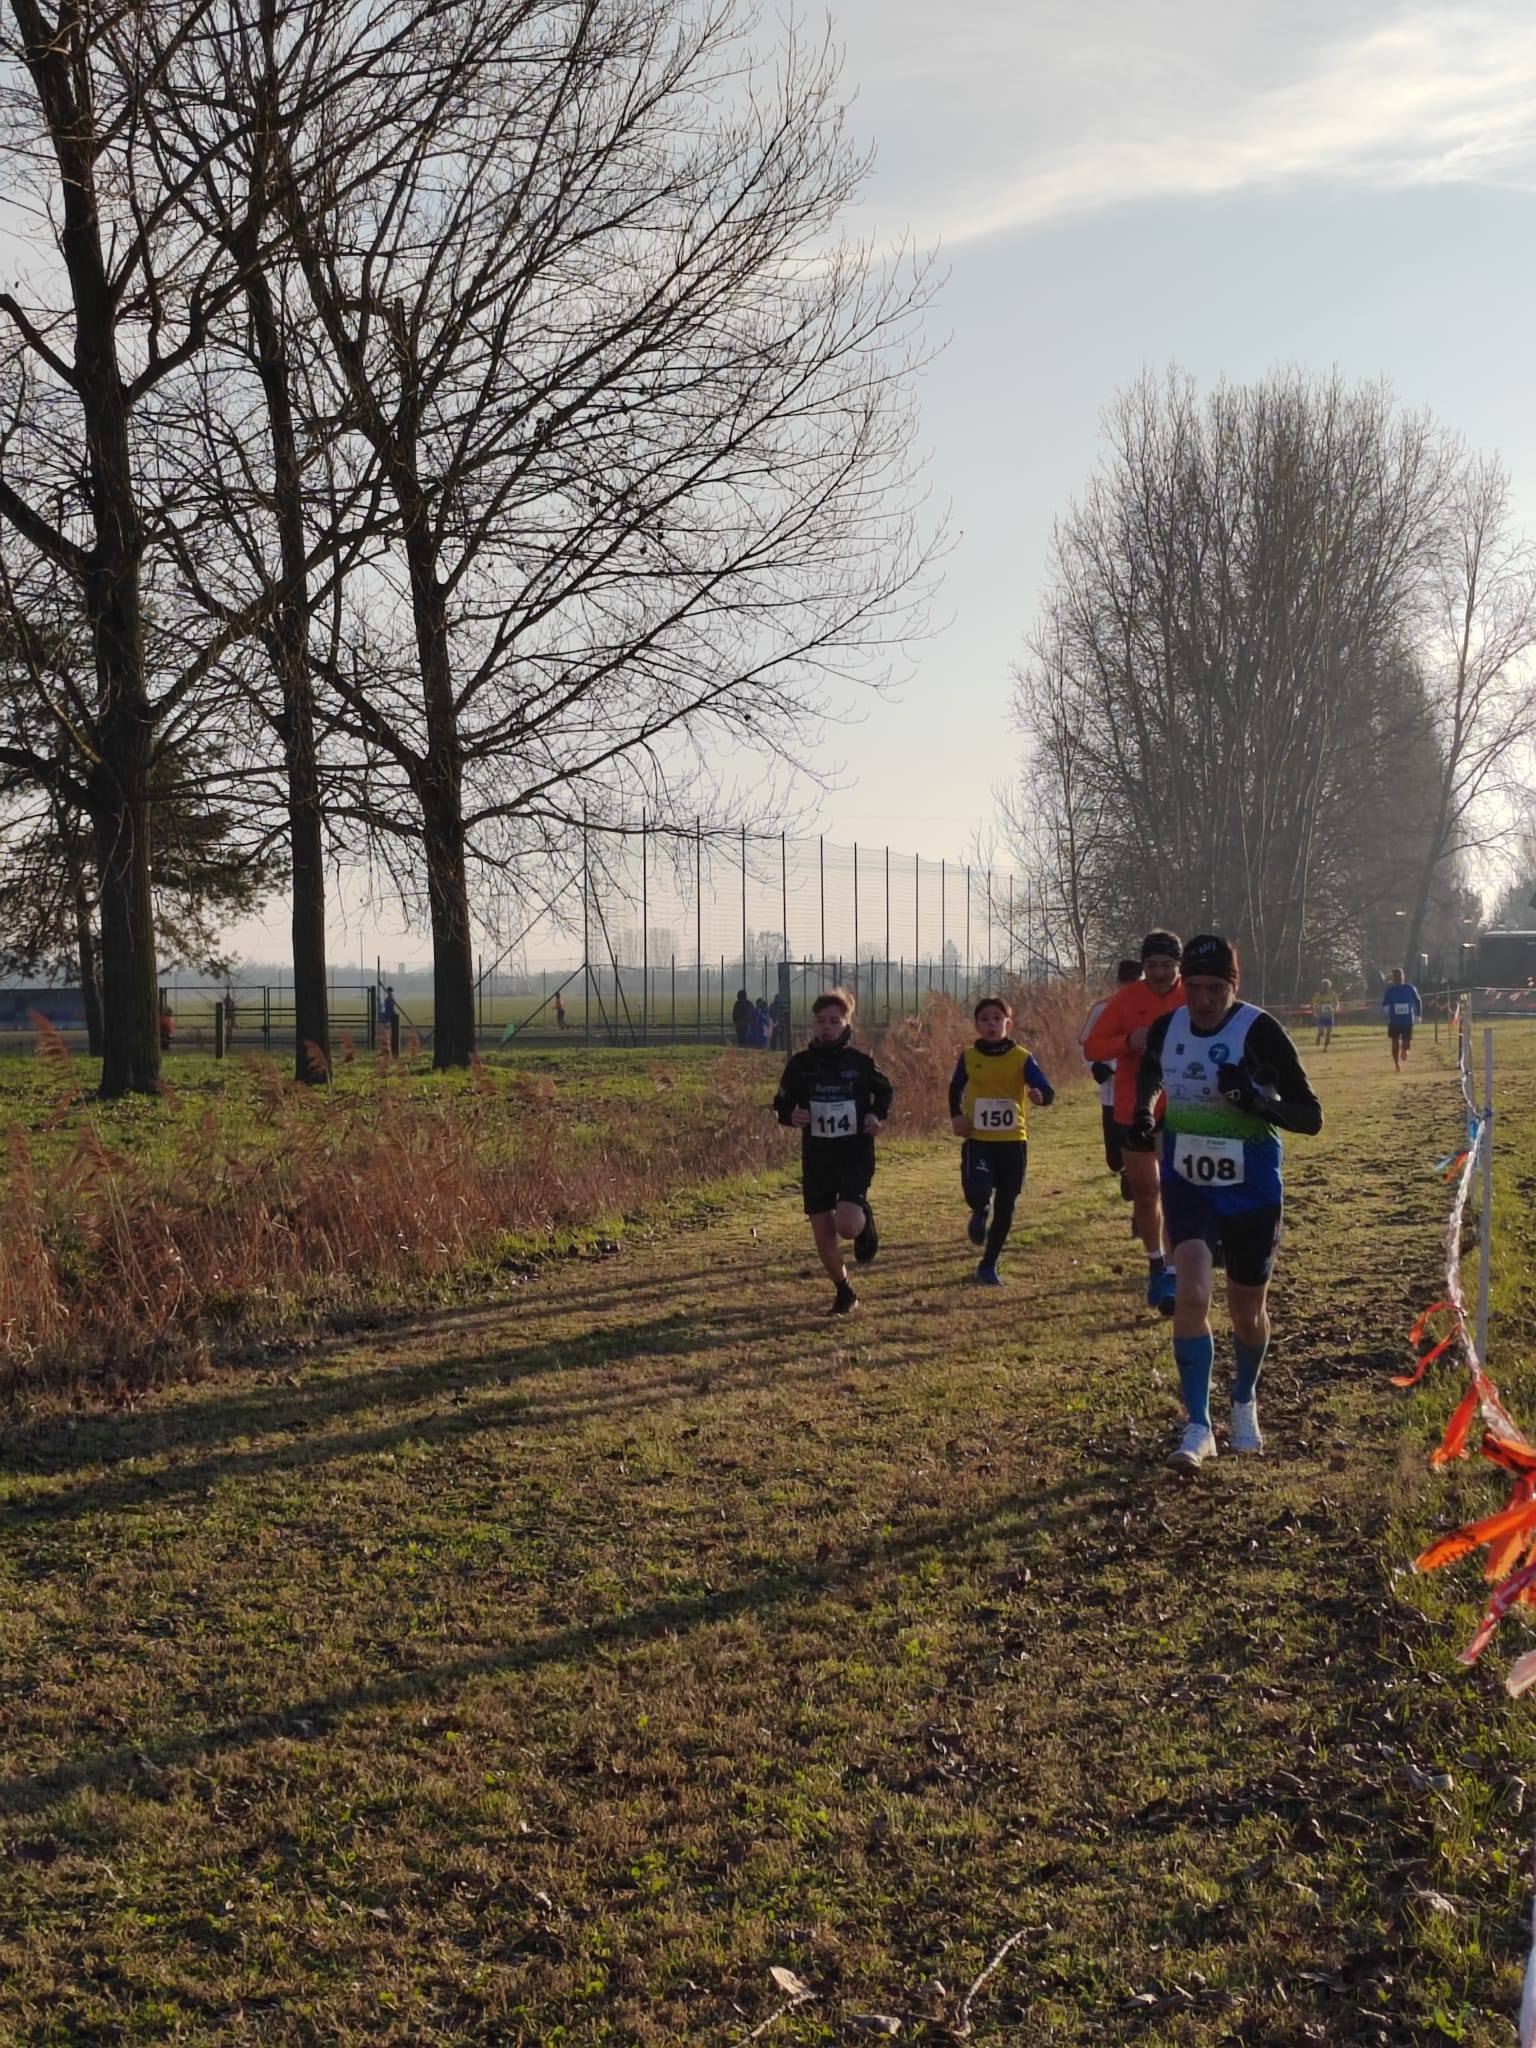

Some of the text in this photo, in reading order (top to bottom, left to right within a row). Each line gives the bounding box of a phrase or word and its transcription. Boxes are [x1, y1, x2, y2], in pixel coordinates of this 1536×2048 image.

[817, 1114, 850, 1133] 114
[980, 1110, 1013, 1127] 150
[1182, 1154, 1236, 1181] 108
